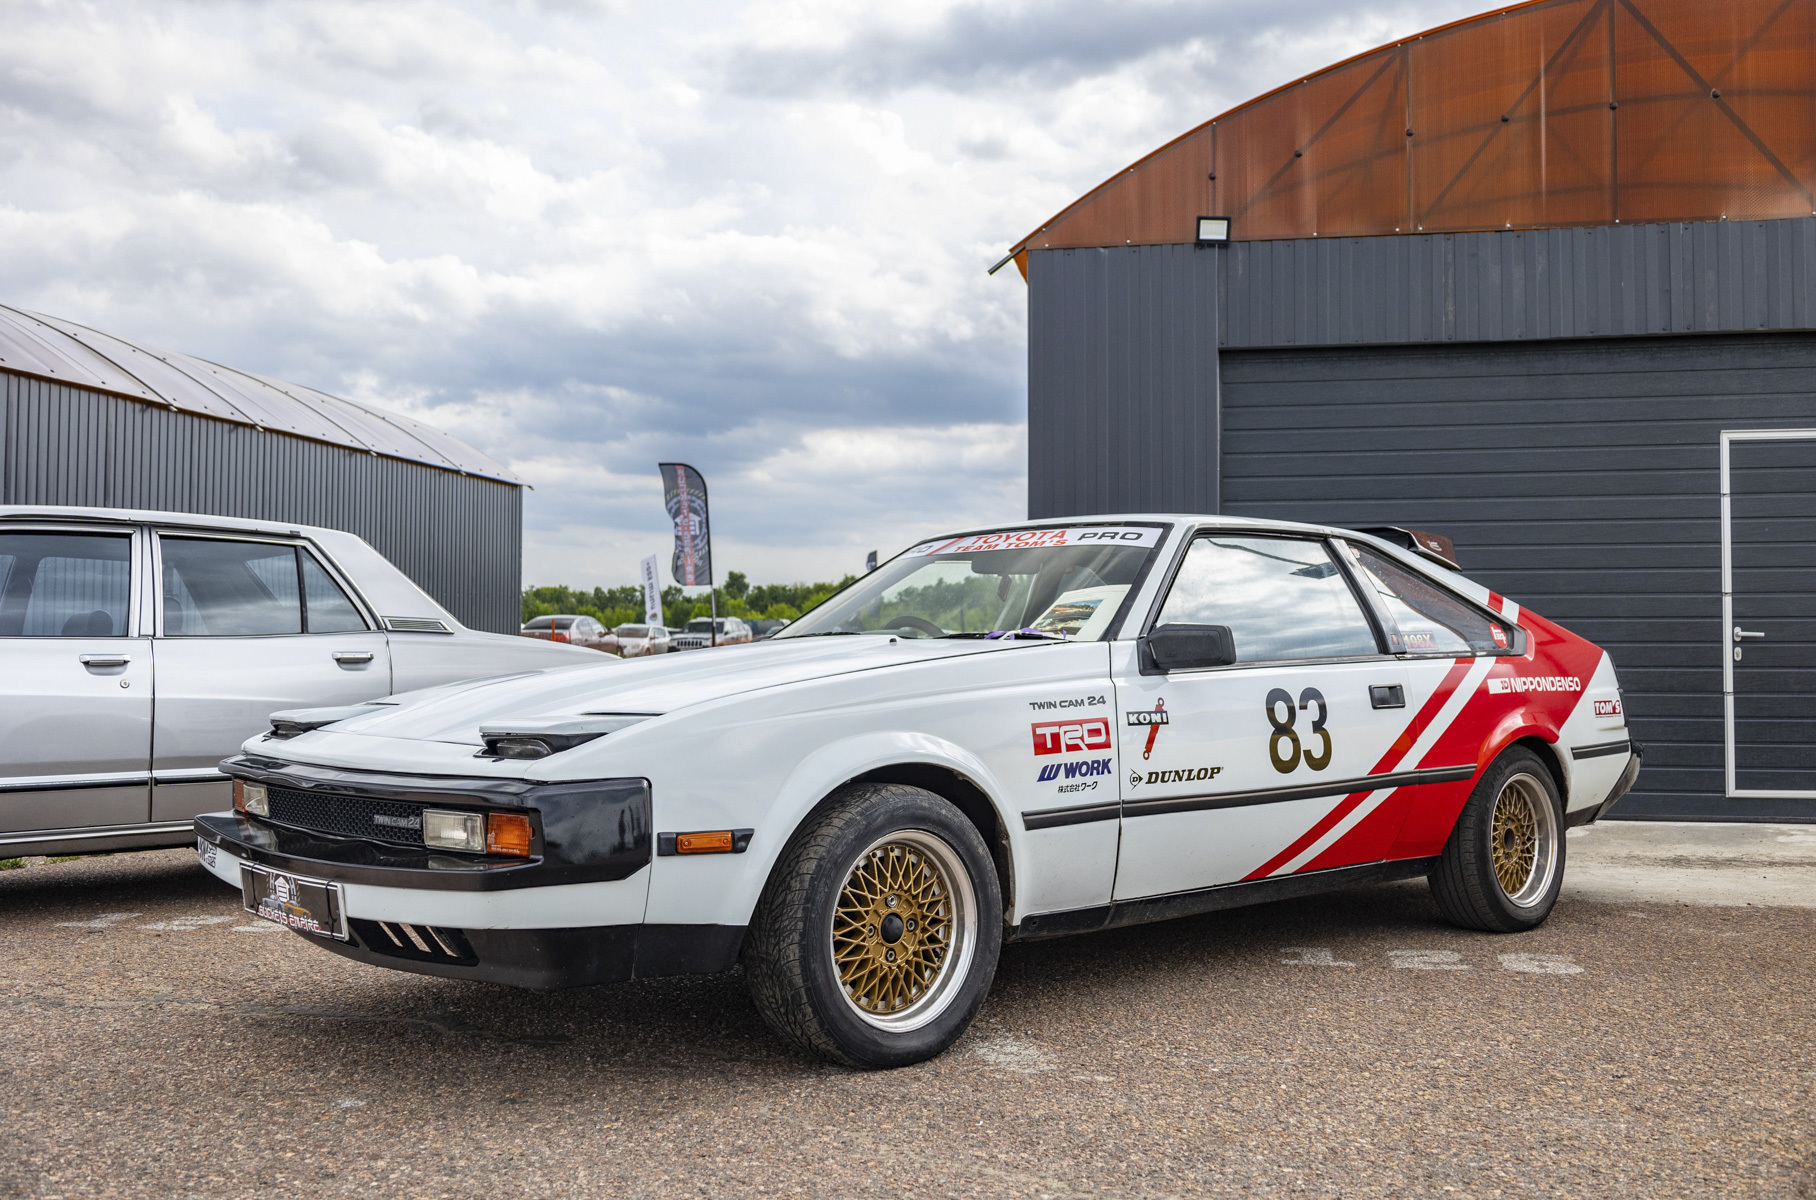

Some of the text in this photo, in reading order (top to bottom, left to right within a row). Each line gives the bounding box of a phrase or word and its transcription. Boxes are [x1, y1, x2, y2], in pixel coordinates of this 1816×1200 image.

[972, 529, 1068, 545] TOYOTA
[1077, 531, 1144, 541] PRO
[954, 538, 1068, 553] TEAM TOM'S
[1510, 676, 1581, 693] NIPPONDENSO
[1029, 695, 1106, 710] TWIN CAM 24
[1594, 698, 1620, 714] TOM'S
[1128, 711, 1168, 725] KONI
[1035, 721, 1107, 753] TRD
[1265, 687, 1333, 775] 83
[1064, 758, 1113, 779] WORK
[1145, 766, 1222, 785] DUNLOP
[1057, 781, 1099, 794] 株式会社ワーク
[374, 814, 420, 829] TWIN CAM 24
